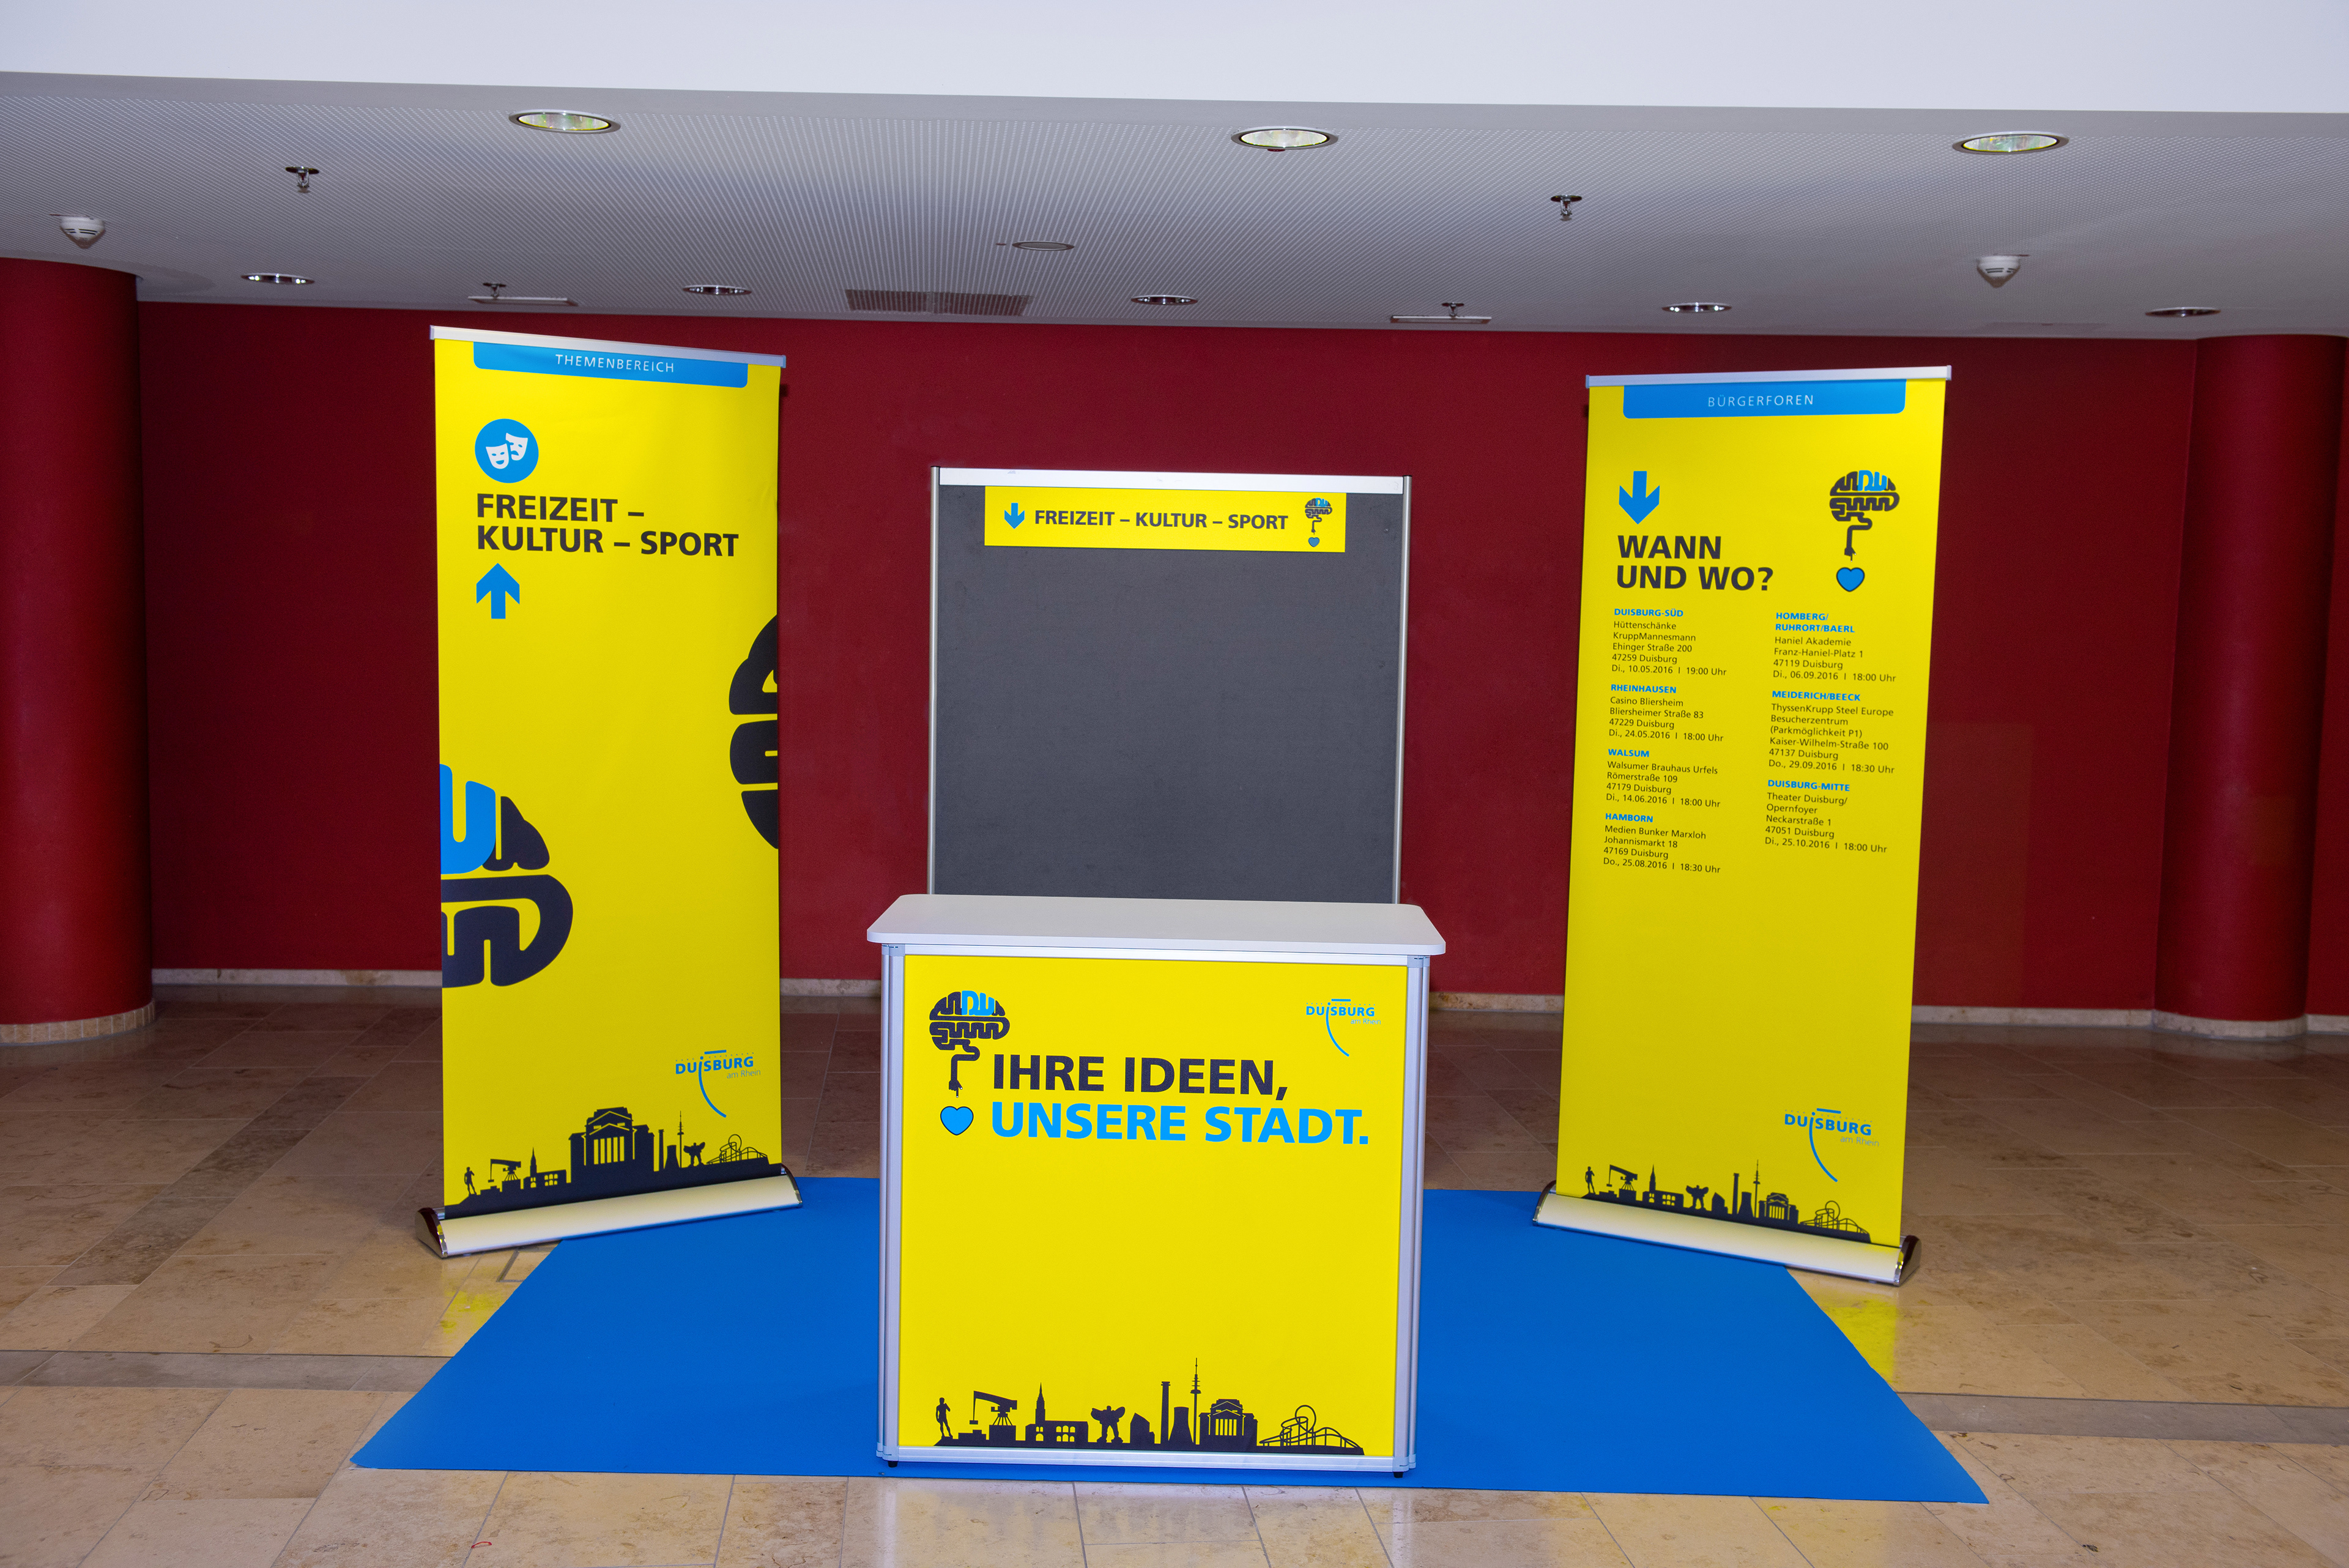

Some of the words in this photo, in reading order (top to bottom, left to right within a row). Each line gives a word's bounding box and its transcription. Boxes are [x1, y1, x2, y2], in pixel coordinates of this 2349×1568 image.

[555, 354, 674, 373] THEMENBEREICH
[1709, 395, 1813, 407] BÜRGERFOREN
[477, 493, 618, 522] FREIZEIT
[1035, 510, 1115, 526] FREIZEIT
[1135, 512, 1208, 528] KULTUR
[1228, 514, 1289, 530] SPORT
[477, 525, 604, 553] KULTUR
[640, 530, 739, 557] SPORT
[1617, 535, 1721, 560] WANN
[1617, 565, 1687, 589] UND
[1698, 566, 1773, 591] WO?
[1614, 608, 1684, 617] DUISBURG-SÜD
[1776, 612, 1829, 621] HOMBERG/
[1614, 620, 1677, 630] Hüttenschänke
[1775, 623, 1855, 633] RUHRORT/BAERL
[1613, 631, 1696, 642] KruppMannesmann
[1775, 636, 1803, 645] Haniel
[1805, 637, 1852, 646] Akademie
[1612, 642, 1645, 653] Ehinger
[1647, 643, 1675, 652] Straße
[1677, 644, 1693, 653] 200
[1774, 647, 1856, 658] Franz-Haniel-Platz
[1639, 654, 1677, 665] Duisburg
[1773, 659, 1800, 667] 47119
[1802, 660, 1843, 671] Duisburg
[1611, 664, 1625, 673] Di.,
[1628, 664, 1673, 674] 10.05.2016
[1687, 667, 1709, 675] 19:00
[1711, 667, 1727, 676] Uhr
[1773, 670, 1787, 679] Di.,
[1790, 671, 1838, 680] 06.09.2016
[1853, 673, 1877, 682] 18:00
[1879, 674, 1896, 682] Uhr
[1611, 683, 1677, 694] RHEINHAUSEN
[1610, 696, 1638, 705] Casino
[1640, 697, 1683, 707] Bliersheim
[1772, 690, 1861, 702] MEIDERICH/BEECK
[1609, 707, 1662, 717] Bliersheimer
[1664, 709, 1691, 718] Straße
[1771, 703, 1834, 715] ThyssenKrupp
[1836, 706, 1858, 715] Steel
[1861, 707, 1894, 718] Europe
[1609, 718, 1635, 727] 47229
[1636, 719, 1674, 730] Duisburg
[1771, 714, 1849, 726] Besucherzentrum
[1609, 729, 1622, 738] Di.,
[1625, 729, 1670, 739] 24.05.2016
[1683, 732, 1705, 741] 18:00
[1770, 725, 1846, 737] (Parkmöglichkeit
[1848, 729, 1863, 738] P1)
[1770, 737, 1869, 749] Kaiser-Wilhelm-Straße
[1873, 742, 1889, 751] 100
[1608, 748, 1650, 757] WALSUM
[1768, 748, 1795, 757] 47137
[1798, 749, 1839, 761] Duisburg
[1607, 760, 1649, 770] Walsumer
[1652, 763, 1691, 773] Brauhaus
[1693, 765, 1718, 775] Urfels
[1768, 759, 1786, 769] Do.,
[1789, 760, 1837, 771] 29.09.2016
[1851, 764, 1876, 773] 18:30
[1878, 765, 1895, 774] Uhr
[1607, 771, 1660, 782] Römerstraße
[1663, 775, 1678, 783] 109
[1606, 782, 1631, 791] 47179
[1634, 784, 1672, 795] Duisburg
[1767, 779, 1850, 792] DUISBURG-MITTE
[1606, 793, 1619, 803] Di.,
[1623, 794, 1668, 804] 14.06.2016
[1680, 798, 1702, 807] 18:00
[1705, 799, 1721, 808] Uhr
[1767, 792, 1802, 801] Theater
[1804, 794, 1848, 807] Duisburg/
[1766, 803, 1818, 816] Opernfoyer
[1605, 812, 1653, 823] HAMBORN
[1766, 814, 1824, 826] Neckarstraße
[1605, 825, 1636, 834] Medien
[1639, 827, 1669, 836] Bunker
[1671, 829, 1706, 839] Marxloh
[1765, 825, 1791, 834] 47051
[1794, 827, 1835, 840] Duisburg
[1604, 836, 1665, 847] Johannismarkt
[1668, 840, 1678, 849] 18
[1765, 836, 1779, 846] Di.,
[1782, 838, 1830, 849] 25.10.2016
[1844, 842, 1868, 852] 18:00
[1871, 844, 1887, 853] Uhr
[1603, 846, 1628, 855] 47169
[1631, 848, 1669, 860] Duisburg
[1603, 857, 1620, 867] Do.,
[1622, 858, 1668, 869] 25.08.2016
[1680, 863, 1702, 872] 18:30
[1705, 865, 1721, 874] Uhr
[993, 1053, 1104, 1092] IHRE
[1124, 1057, 1288, 1101] IDEEN,
[992, 1101, 1186, 1141] UNSERE
[1204, 1105, 1369, 1145] STADT.
[1856, 1137, 1879, 1146] Rhein
